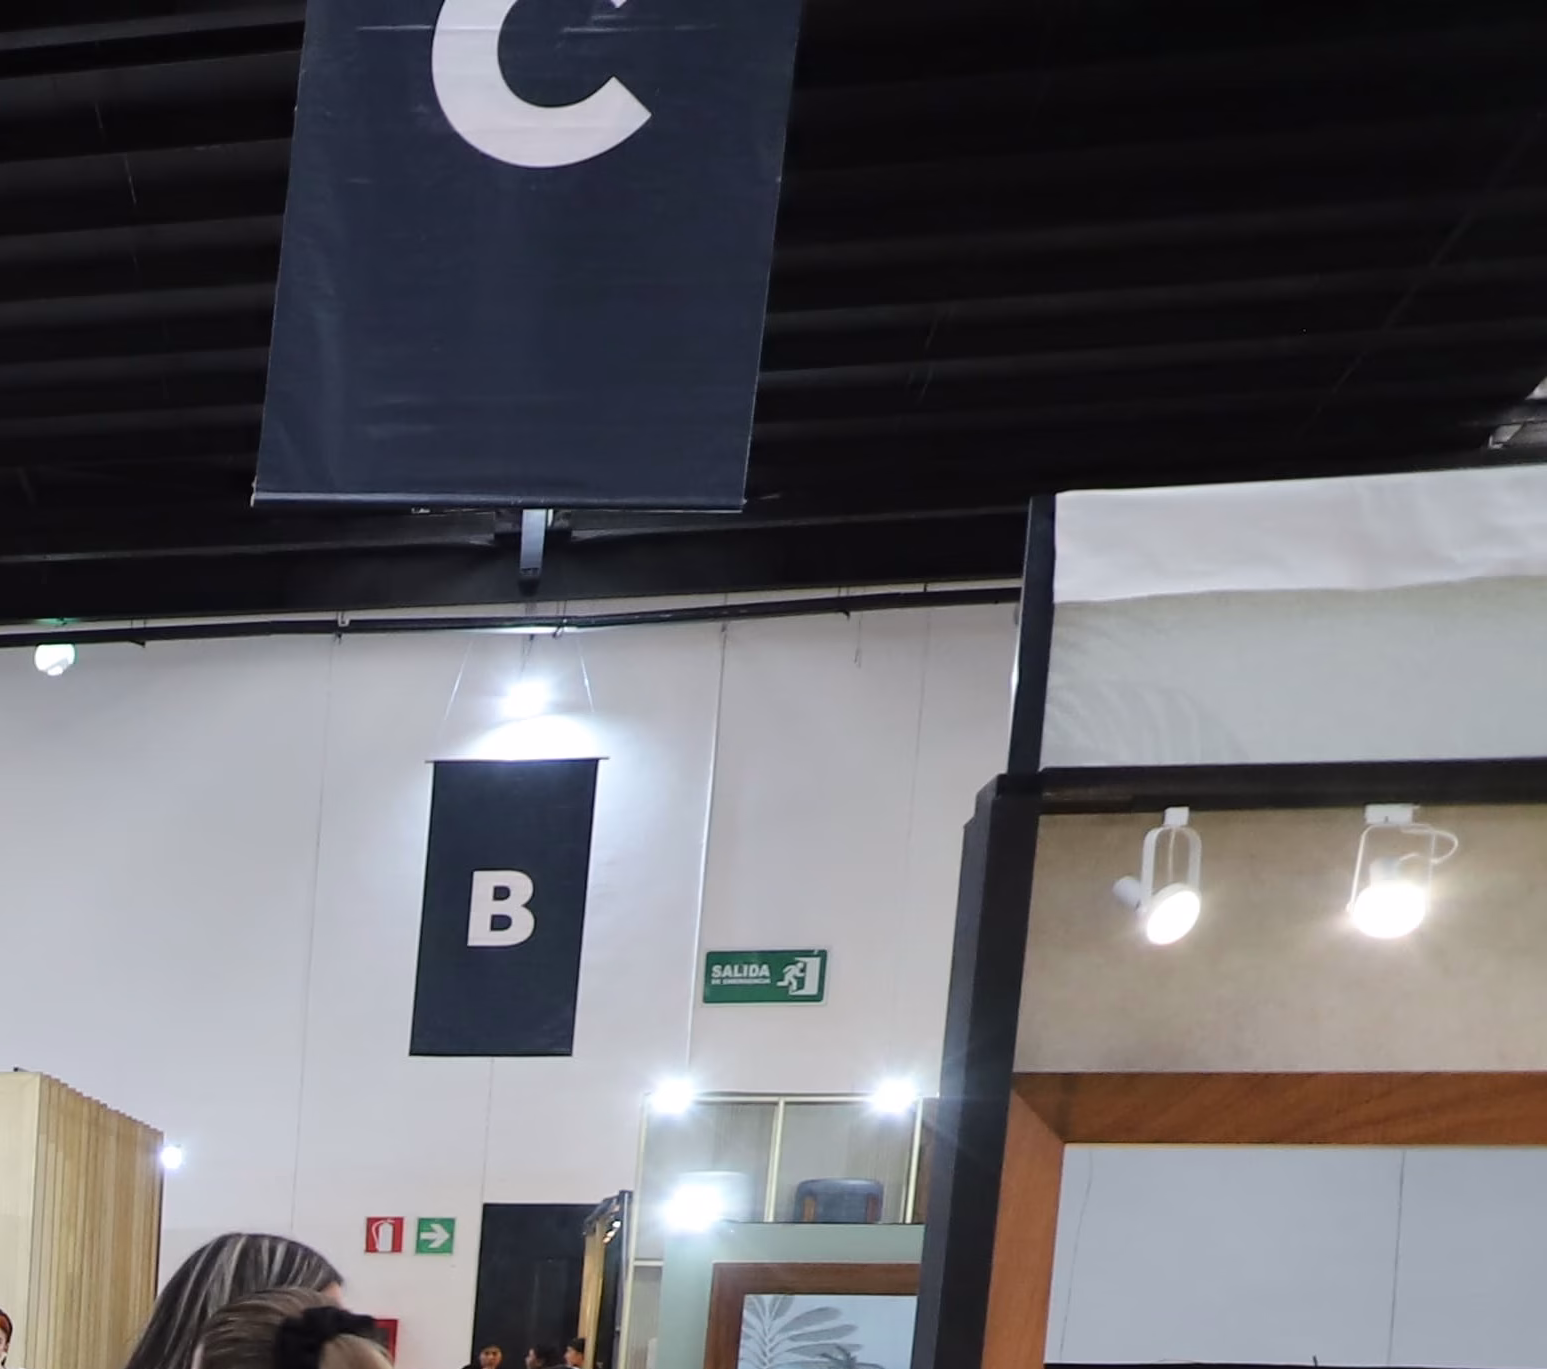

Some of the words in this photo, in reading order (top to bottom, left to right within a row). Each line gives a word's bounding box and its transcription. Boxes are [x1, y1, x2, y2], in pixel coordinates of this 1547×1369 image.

[432, 0, 652, 168] C
[466, 869, 535, 948] B
[711, 964, 771, 977] SALIDA
